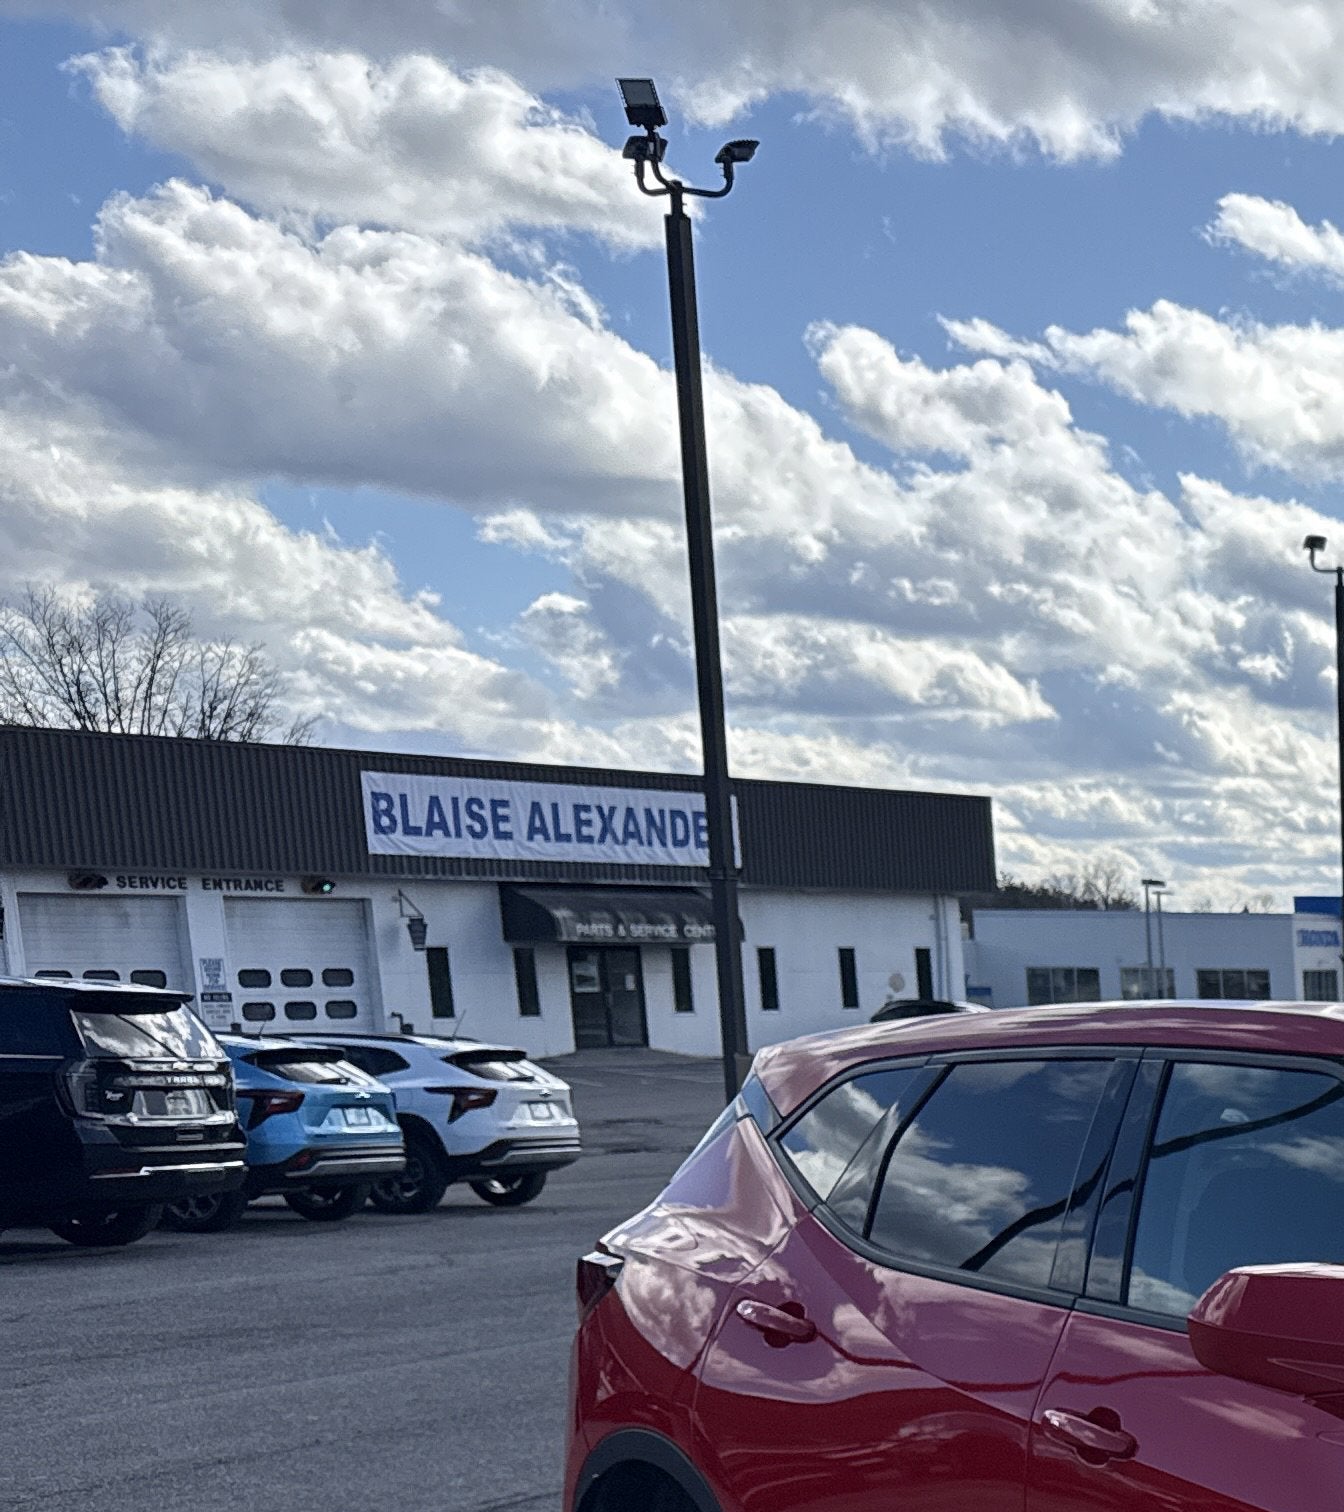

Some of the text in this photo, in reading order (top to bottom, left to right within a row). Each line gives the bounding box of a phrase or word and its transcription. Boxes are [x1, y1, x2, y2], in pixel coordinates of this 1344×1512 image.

[370, 790, 709, 850] BLAISE ALEXANDE
[116, 876, 285, 892] SERVICE ENTRANCE
[576, 923, 613, 937] PARTS
[629, 923, 678, 937] SERVICE
[683, 924, 716, 938] CENT
